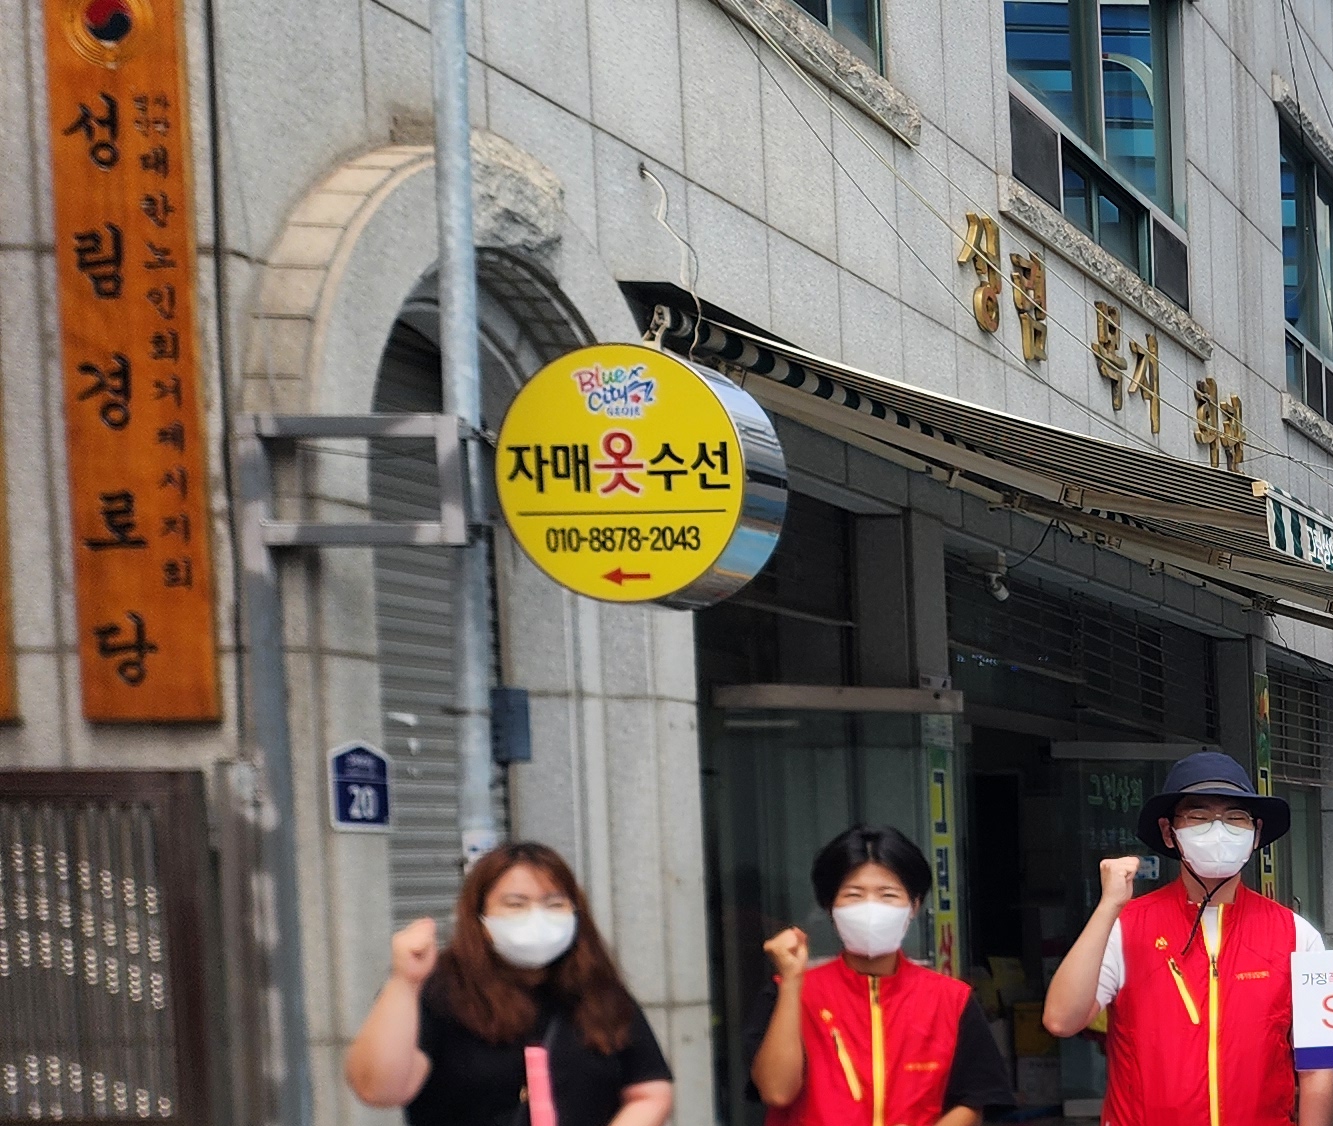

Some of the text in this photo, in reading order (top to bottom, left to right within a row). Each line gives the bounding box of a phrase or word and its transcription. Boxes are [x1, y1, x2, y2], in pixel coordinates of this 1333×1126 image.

[957, 212, 1047, 362] 성림
[1091, 300, 1161, 435] 복지
[62, 91, 158, 689] 성림경로당
[573, 365, 628, 393] Blue
[588, 384, 632, 412] City
[507, 432, 731, 494] 자매옷수선
[546, 525, 701, 552] 010-8878-2043
[347, 785, 380, 820] 20
